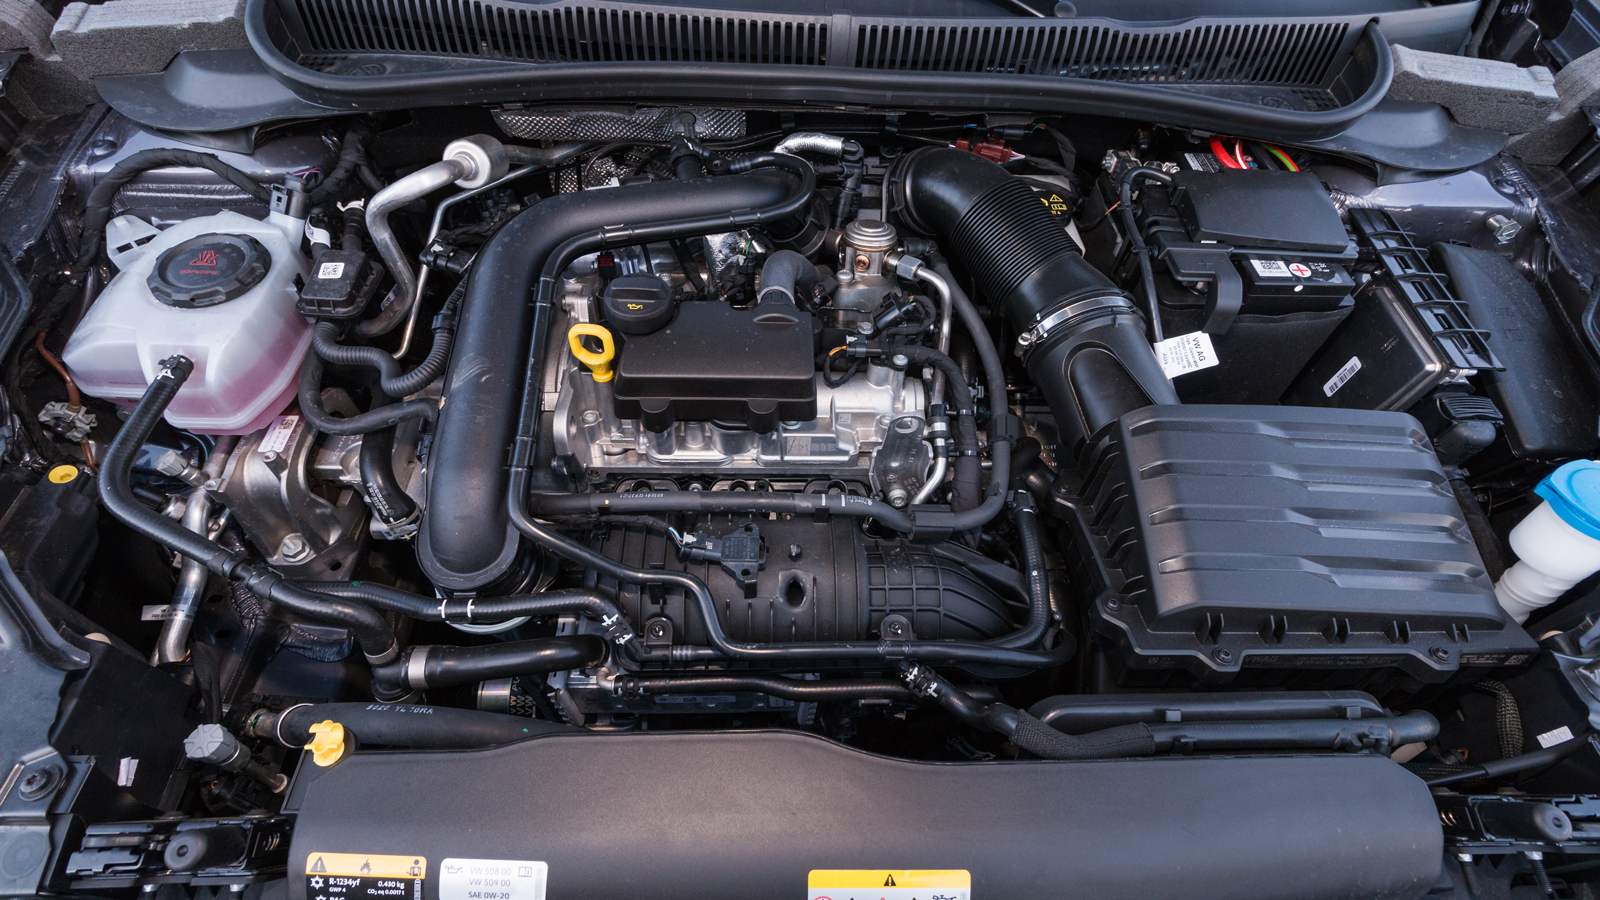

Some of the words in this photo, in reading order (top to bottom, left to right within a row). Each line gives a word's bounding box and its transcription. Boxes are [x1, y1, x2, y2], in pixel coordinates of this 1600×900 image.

[1192, 336, 1202, 349] VW
[1196, 350, 1206, 362] AG
[469, 867, 482, 875] VW
[485, 867, 500, 876] 508
[501, 868, 512, 876] 00
[328, 877, 361, 888] R-1234yf
[377, 880, 396, 888] 0.430
[396, 881, 405, 890] kg
[469, 878, 482, 886] VW
[484, 878, 499, 887] 509
[500, 879, 511, 887] 00
[468, 891, 482, 899] SAE
[483, 892, 510, 900] 0W-20
